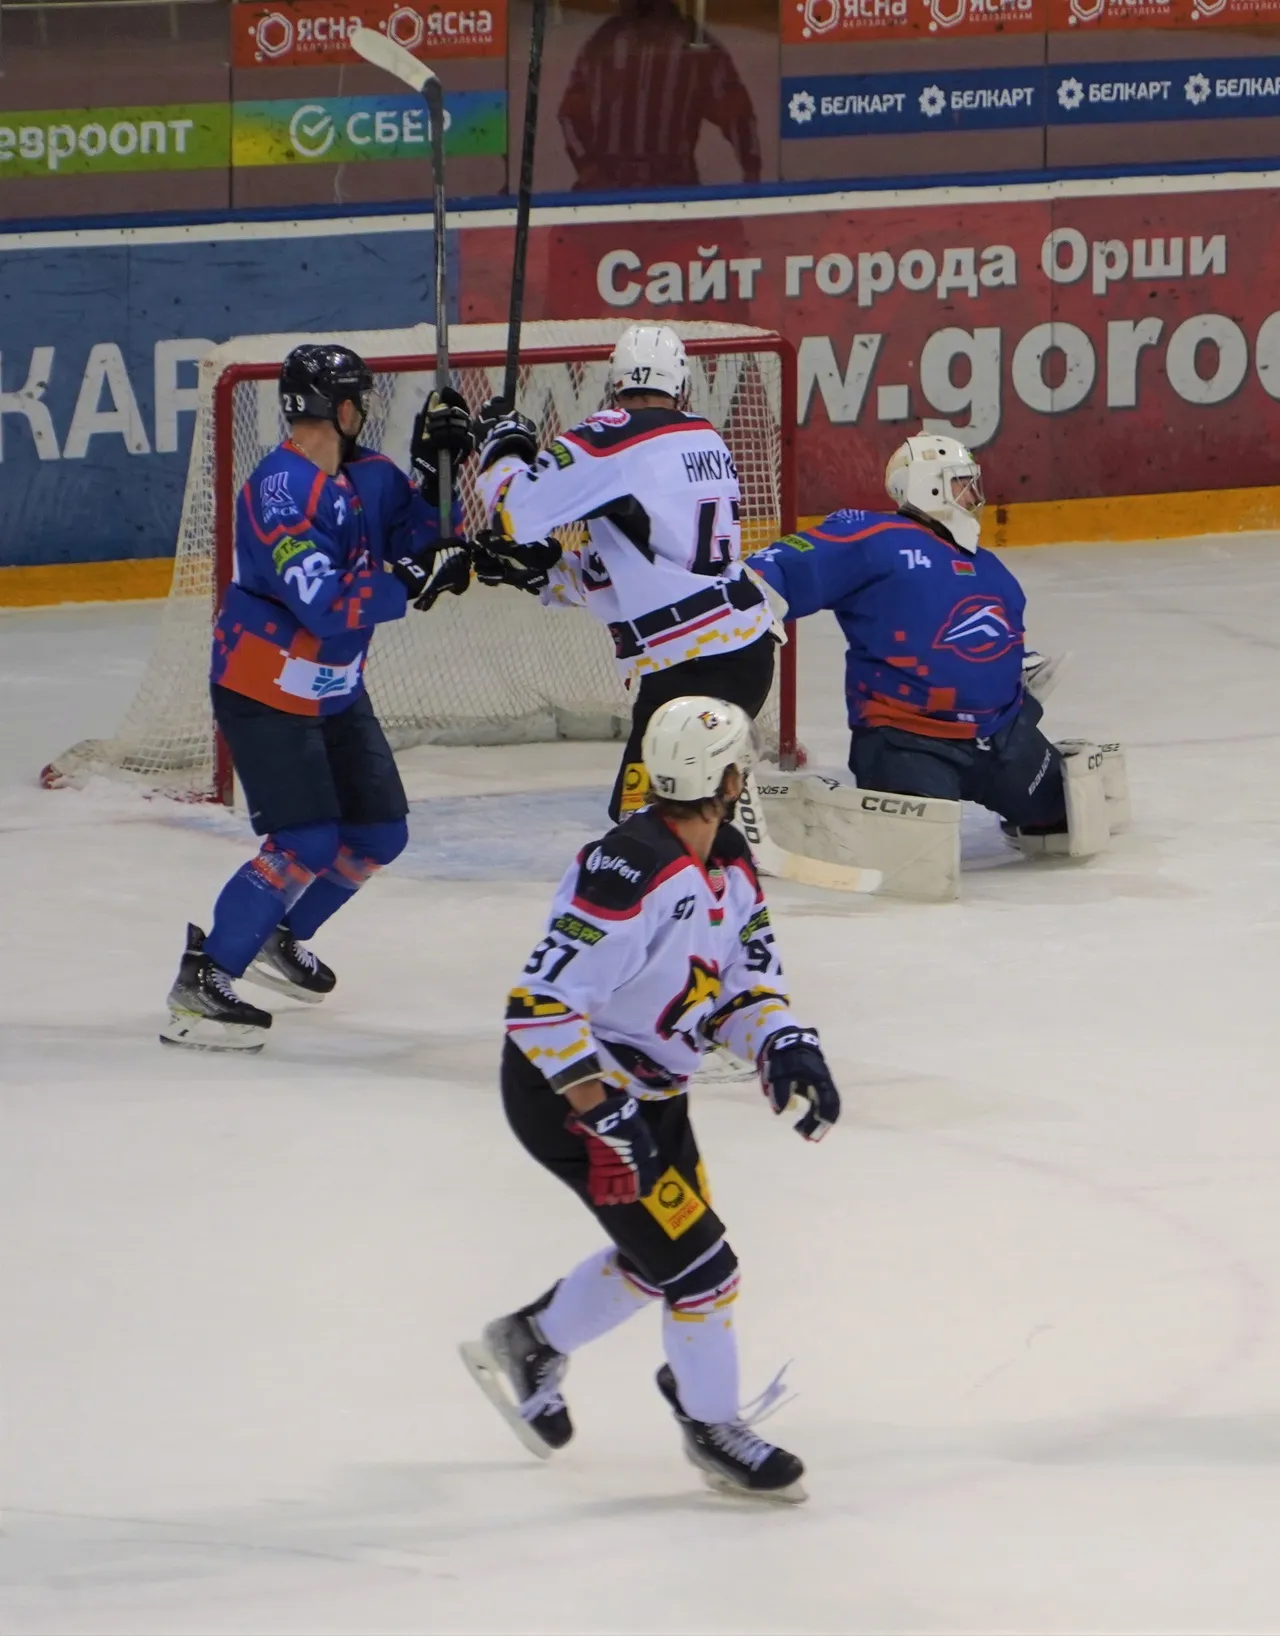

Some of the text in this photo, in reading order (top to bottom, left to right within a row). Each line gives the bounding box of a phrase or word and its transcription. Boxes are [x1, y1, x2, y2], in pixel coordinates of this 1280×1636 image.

[821, 87, 1035, 116] БЕЛКАРТ БЕЛКАРТ
[1089, 80, 1172, 103] БЕЛКАРТ
[596, 226, 1227, 308] Сайт города Орши
[630, 366, 652, 386] 47
[282, 393, 306, 413] 29
[899, 549, 932, 570] 74
[861, 796, 927, 818] CCM
[671, 894, 696, 920] 97
